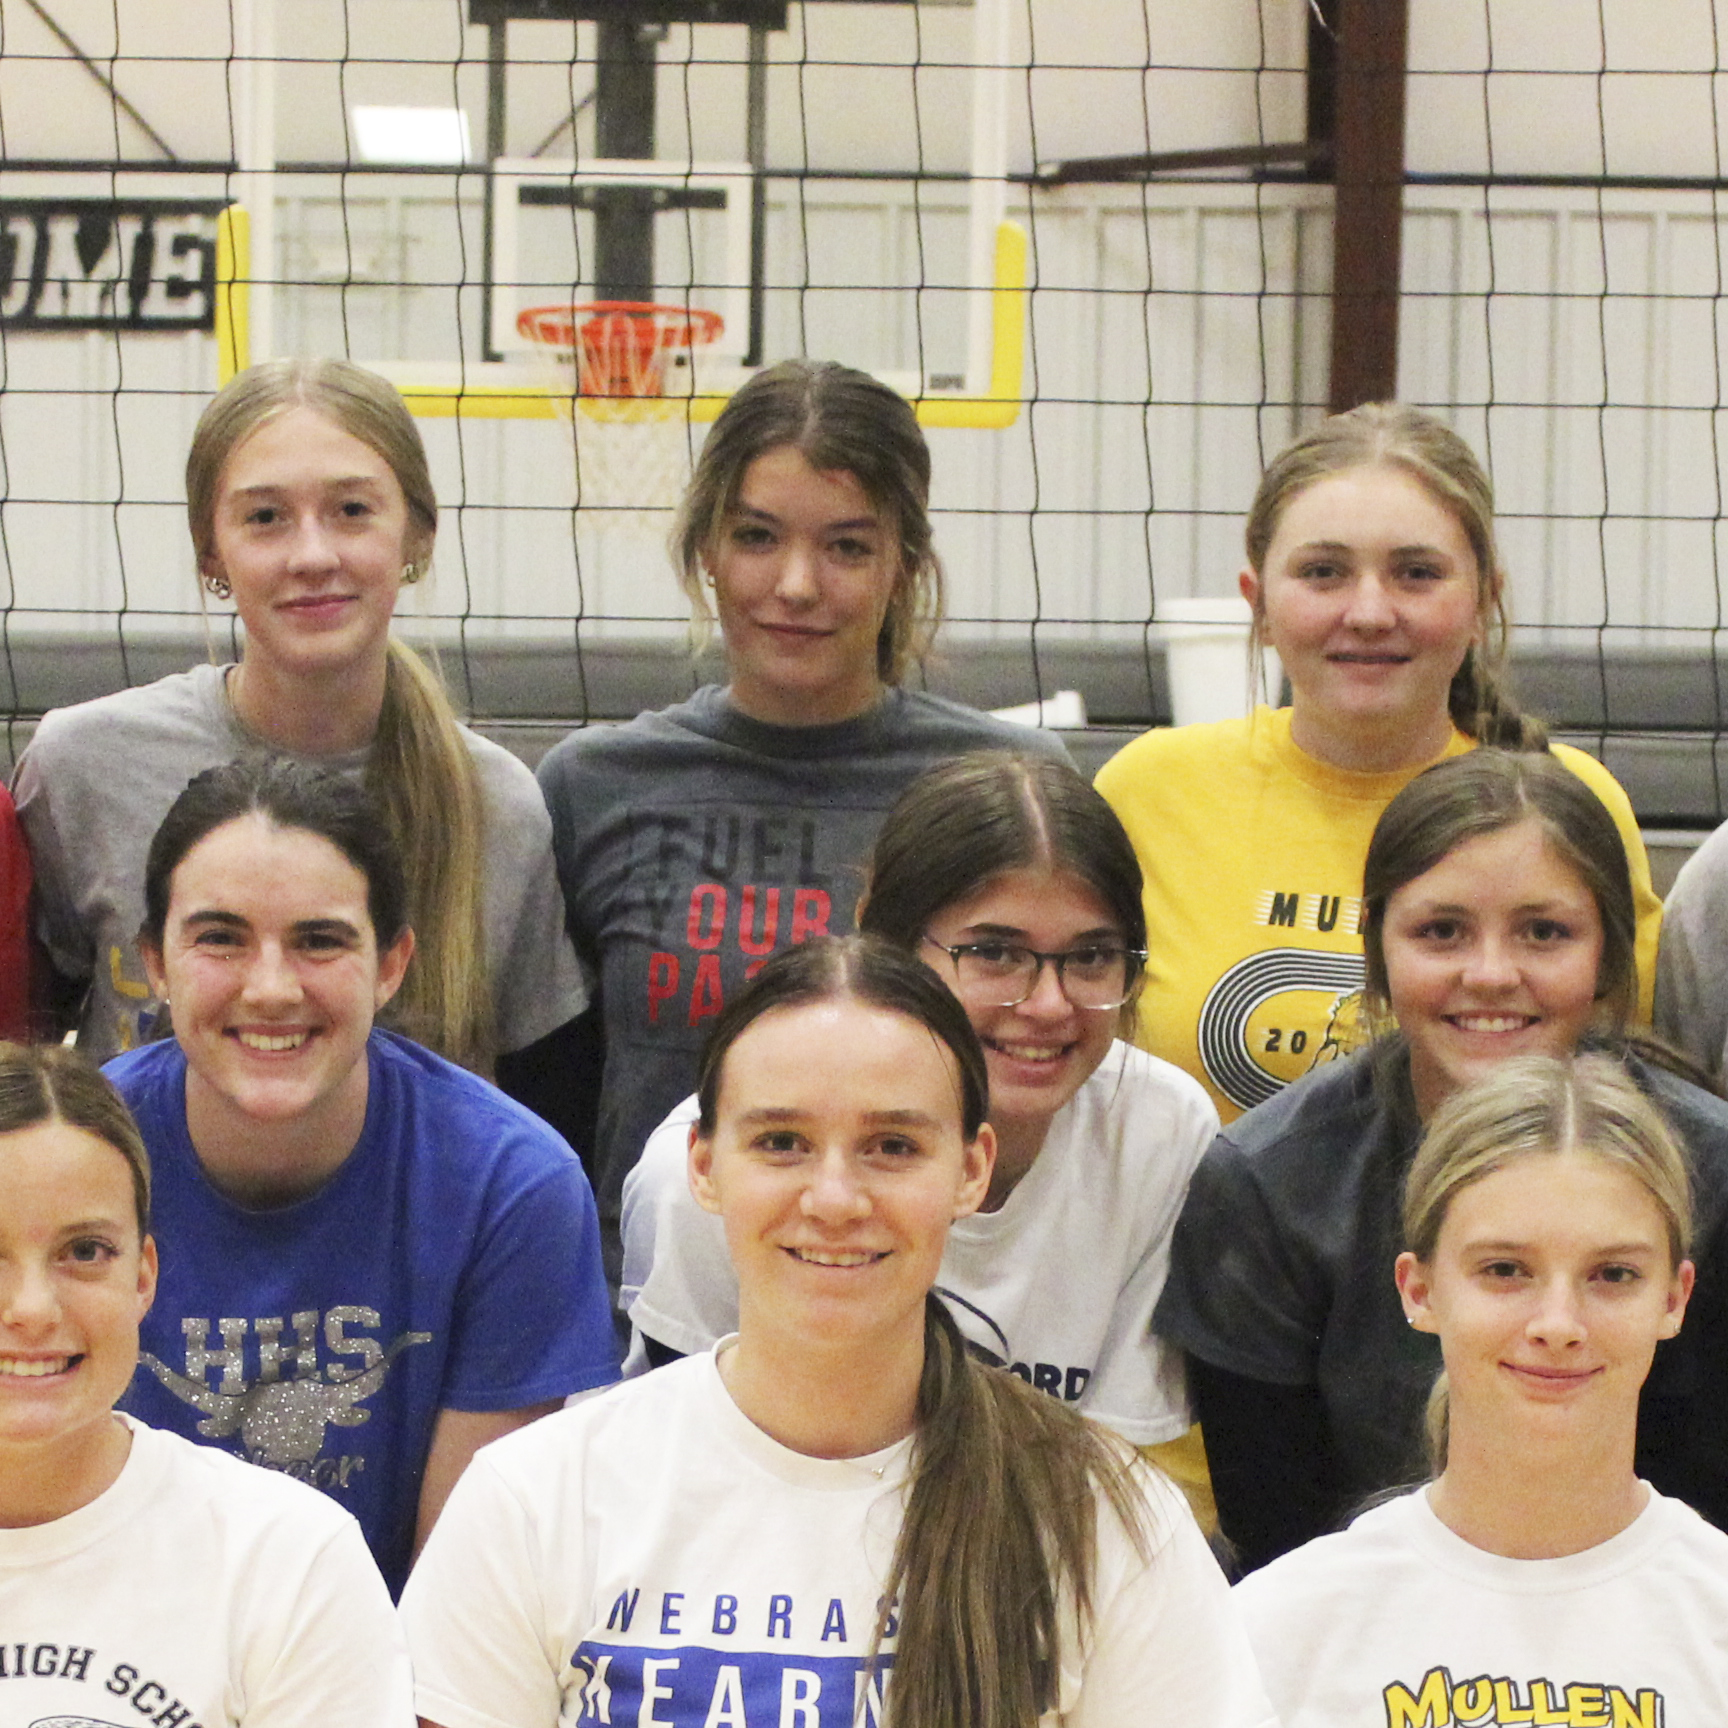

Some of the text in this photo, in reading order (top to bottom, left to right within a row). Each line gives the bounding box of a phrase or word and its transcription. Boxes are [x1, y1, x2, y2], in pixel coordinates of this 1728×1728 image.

[647, 952, 769, 1027] PA
[1265, 1028, 1308, 1055] 20
[180, 1304, 382, 1397] HHS
[1008, 1361, 1092, 1402] ORD
[605, 1587, 902, 1644] NEBRAS
